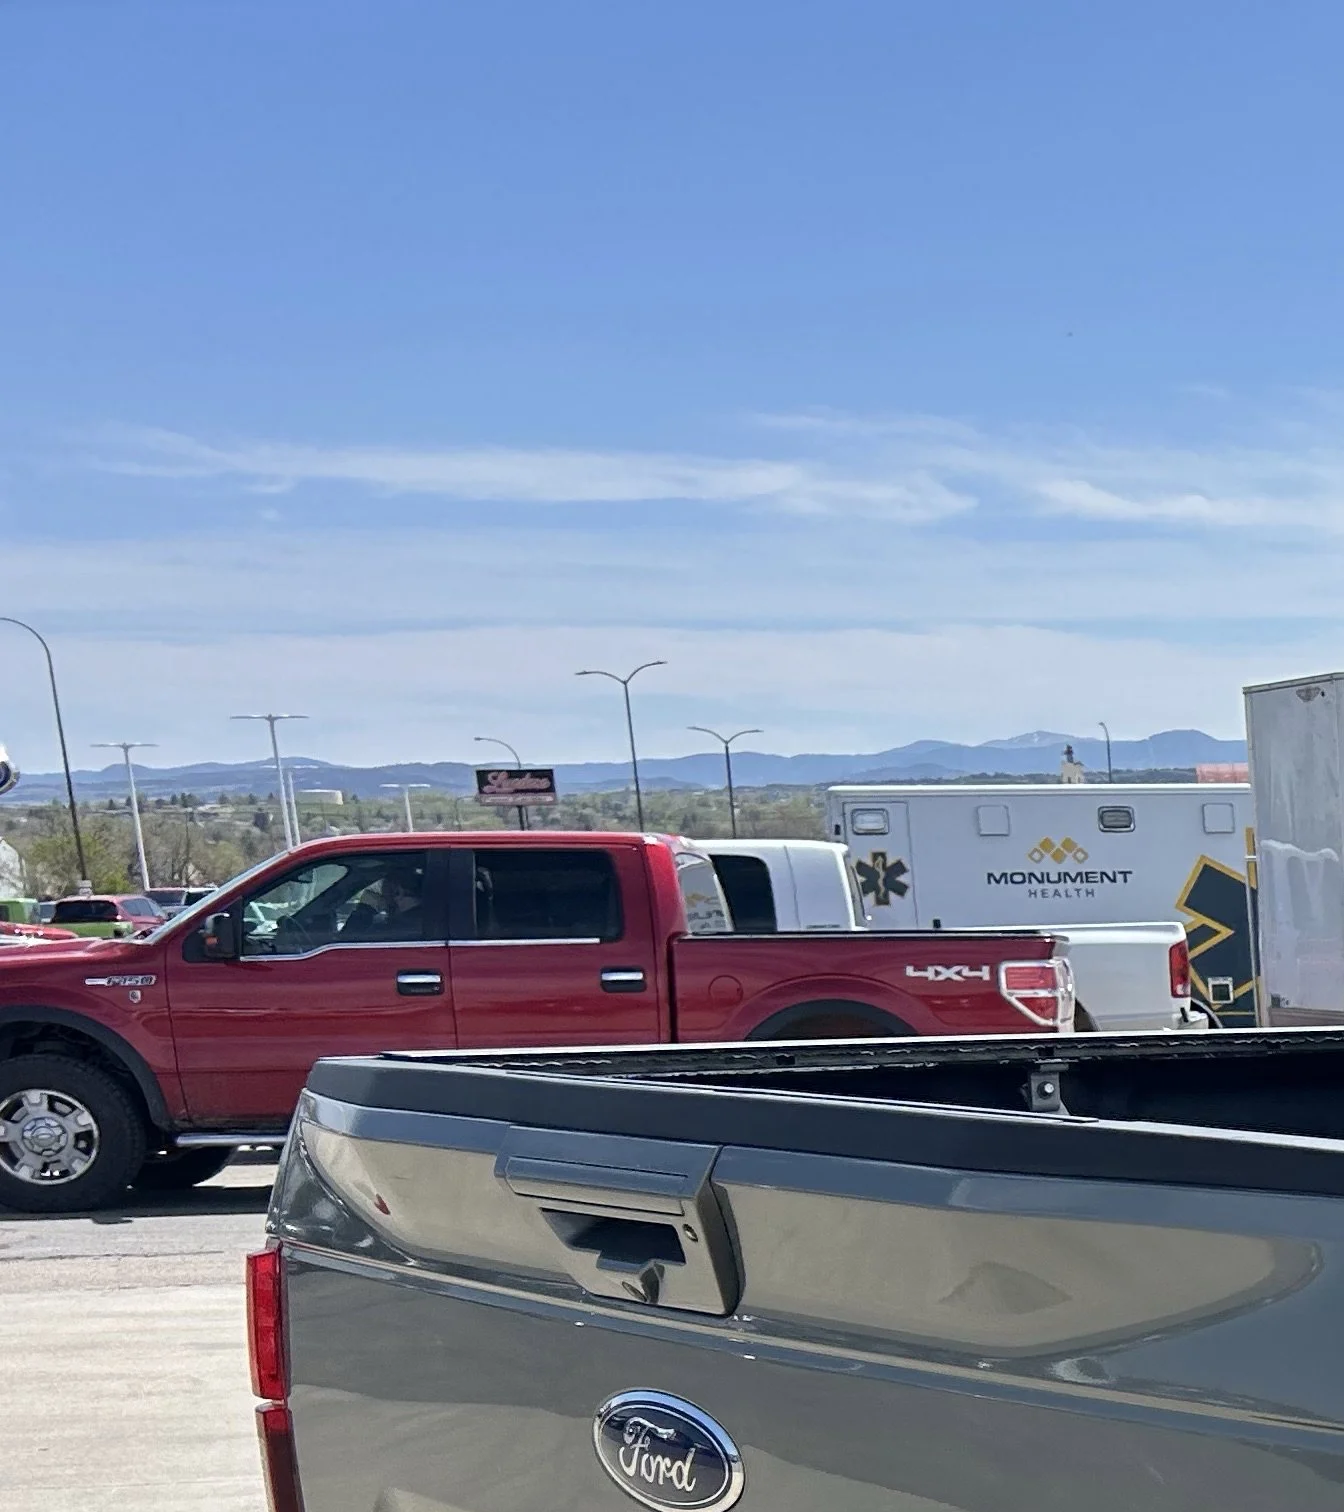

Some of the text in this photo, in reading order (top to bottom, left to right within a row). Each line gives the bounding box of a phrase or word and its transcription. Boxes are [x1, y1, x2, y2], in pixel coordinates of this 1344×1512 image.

[987, 871, 1133, 885] MONUMENT
[1028, 888, 1095, 899] HEALTH
[618, 1416, 698, 1492] Ford
